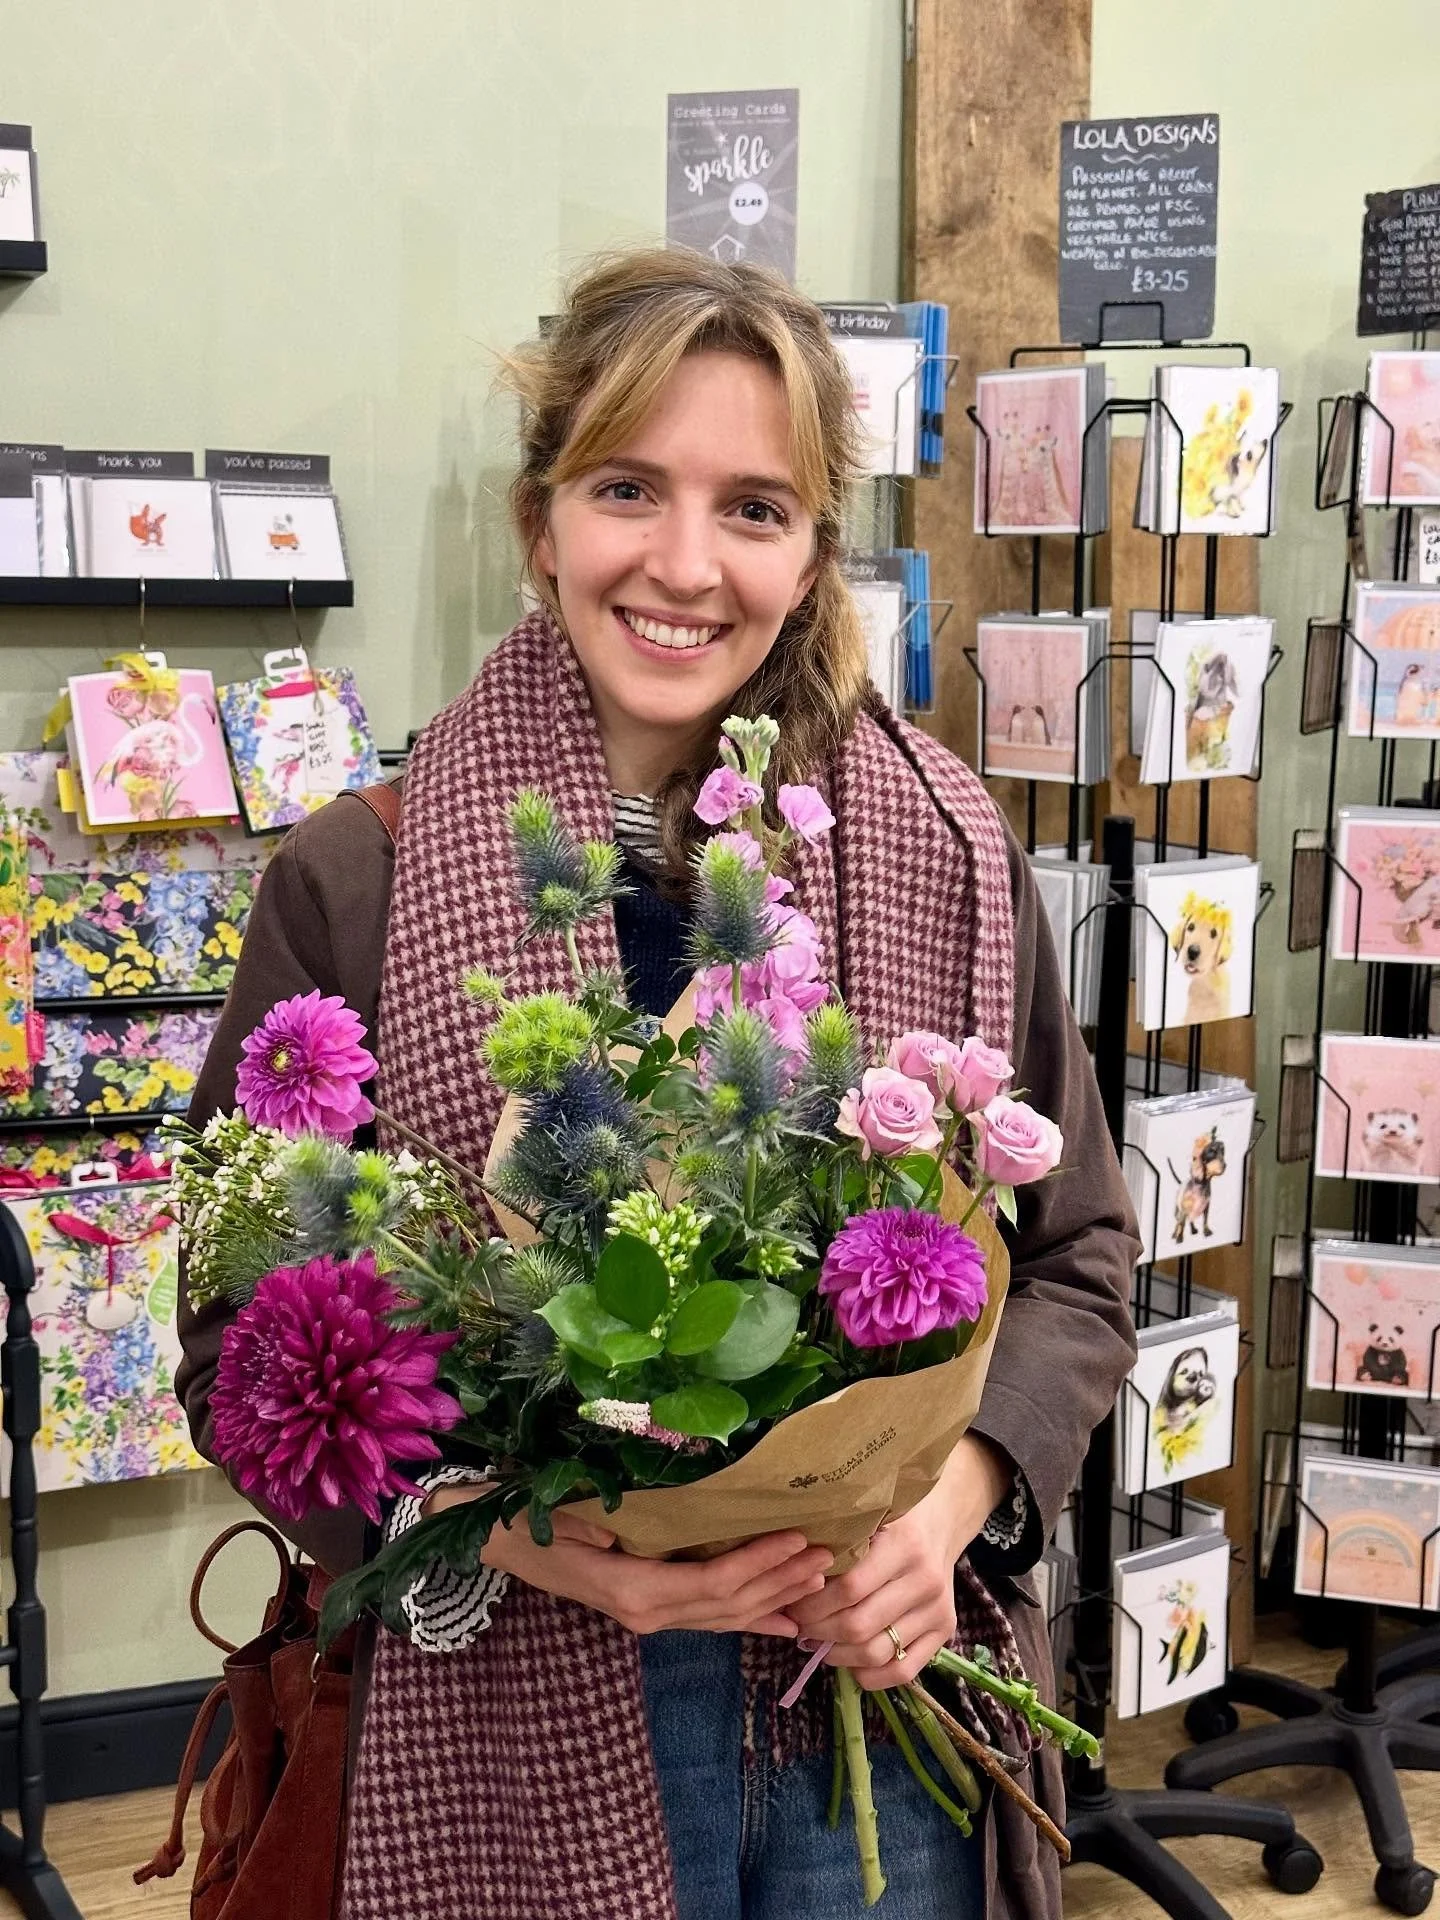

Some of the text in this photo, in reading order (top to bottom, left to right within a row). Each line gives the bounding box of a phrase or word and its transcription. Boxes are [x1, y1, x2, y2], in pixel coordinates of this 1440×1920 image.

[673, 103, 787, 119] Greeting Cards
[1073, 118, 1218, 153] LOLA DESIGNS
[684, 135, 775, 196] sparkle
[1148, 182, 1173, 197] ALL
[1402, 190, 1440, 212] PLAN
[840, 312, 892, 333] birthday
[98, 456, 162, 469] thank you
[224, 455, 311, 471] you've passed
[880, 1426, 895, 1440] 24
[864, 1432, 897, 1459] STUDIO
